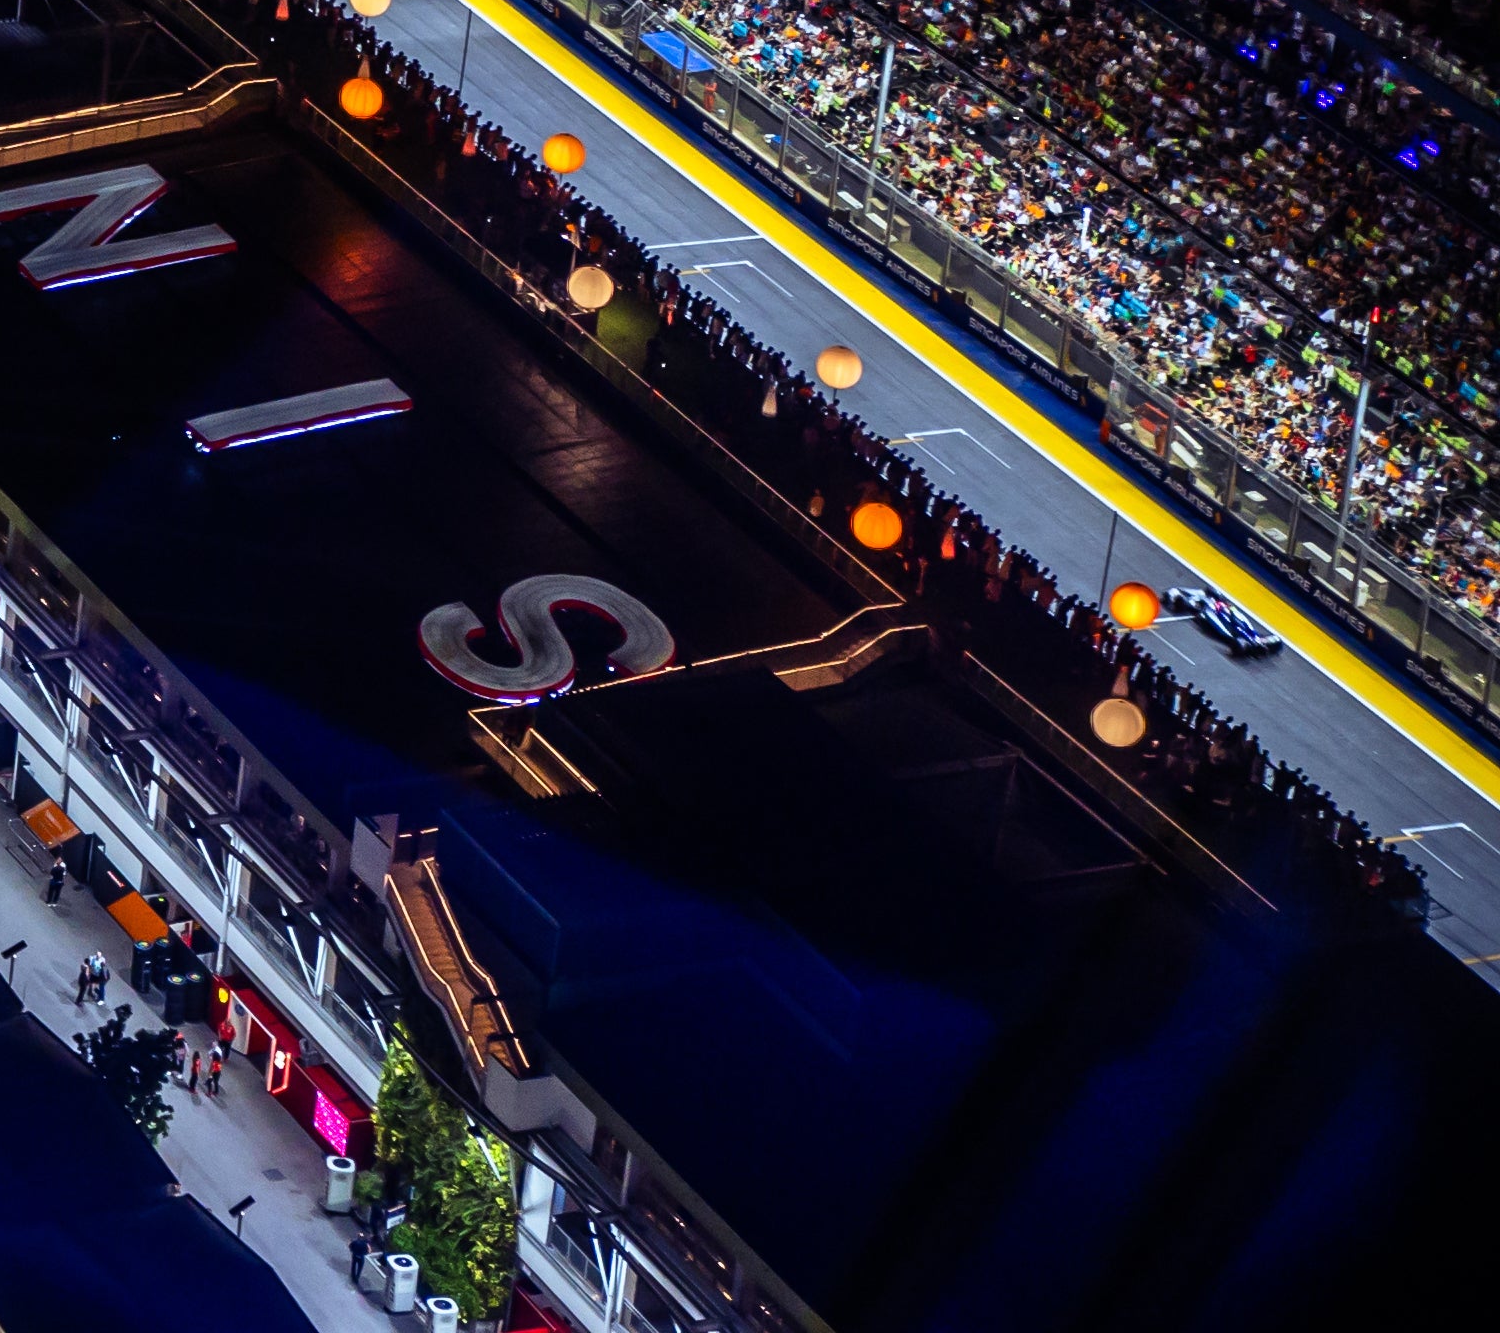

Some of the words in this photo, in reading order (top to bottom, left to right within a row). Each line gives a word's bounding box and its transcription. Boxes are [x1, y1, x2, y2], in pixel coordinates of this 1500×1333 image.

[968, 316, 1028, 365] SINGAPORE
[1029, 361, 1079, 401] AIRLINES
[1246, 537, 1311, 593] SINGAPORE
[1313, 590, 1365, 633] AIRLINES
